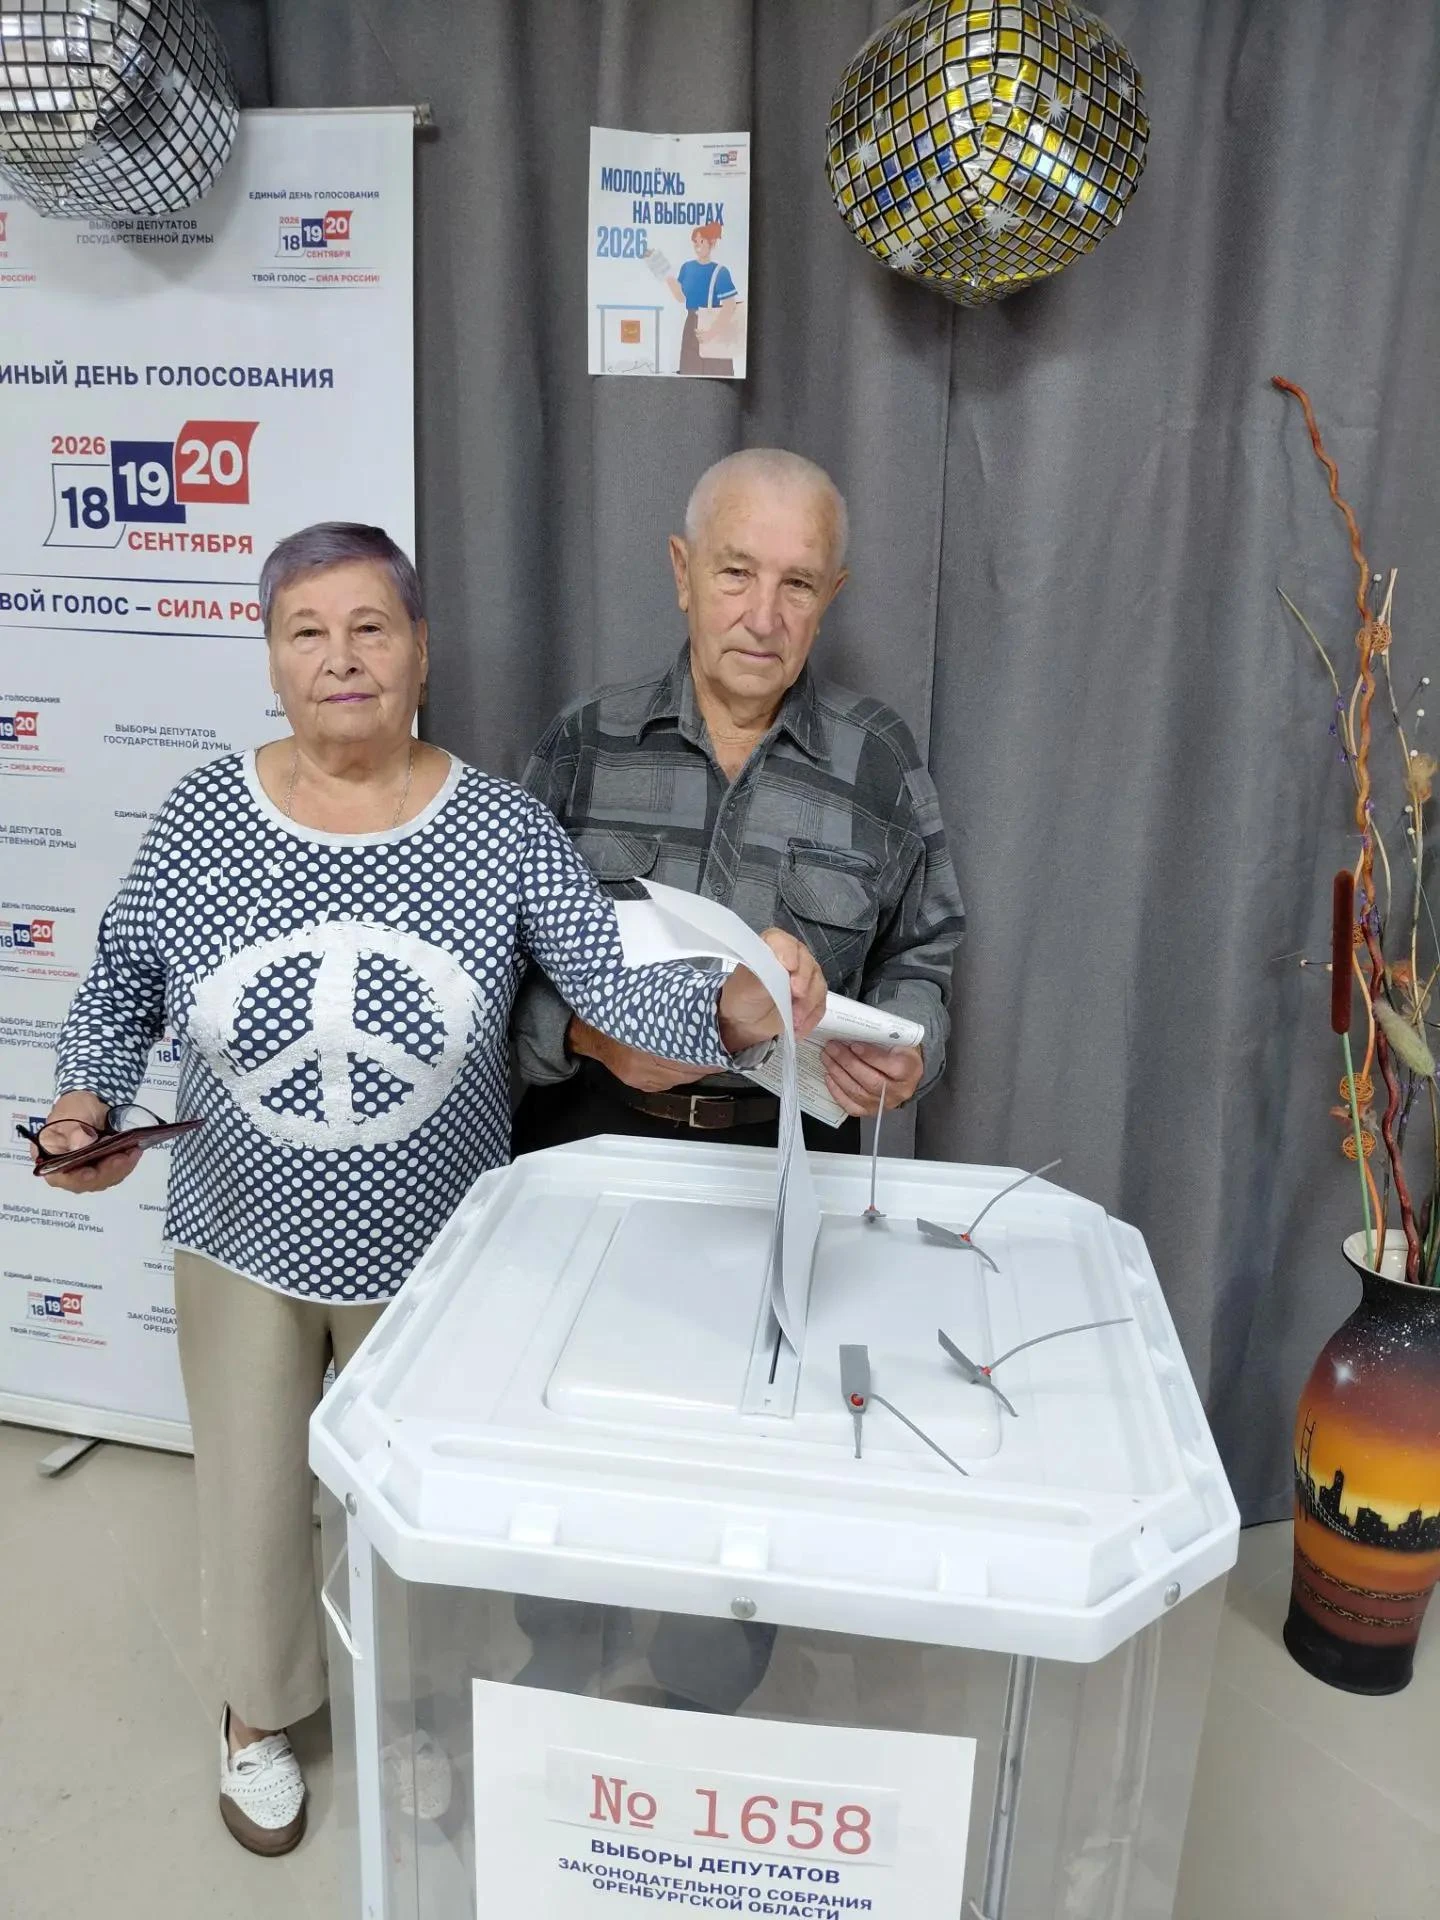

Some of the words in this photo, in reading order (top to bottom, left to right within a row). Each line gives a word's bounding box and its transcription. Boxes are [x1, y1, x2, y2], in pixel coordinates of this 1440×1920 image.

[601, 167, 685, 198] МОЛОДЁЖЬ
[249, 189, 287, 200] ЕДИНЫЙ
[289, 191, 312, 200] ДЕНЬ
[314, 191, 380, 199] ГОЛОСОВАНИЯ
[633, 200, 652, 224] НА
[654, 201, 724, 226] ВЫБОРАХ
[136, 220, 198, 231] ДЕПУТАТОВ
[282, 235, 300, 251] 18
[303, 225, 322, 242] 19
[325, 216, 348, 234] 20
[77, 232, 179, 245] ГОСУДАРСТВЕННОЙ
[181, 234, 214, 245] ДУМЫ
[596, 225, 648, 259] 2026
[252, 272, 276, 282] ТВОЙ
[277, 274, 307, 282] ГОЛОС
[75, 365, 139, 388] ДЕНЬ
[146, 366, 334, 388] ГОЛОСОВАНИЯ
[51, 435, 106, 455] 2026
[61, 486, 110, 530] 18
[118, 461, 170, 507] 19
[180, 439, 243, 486] 20
[128, 531, 253, 554] СЕНТЯБРЯ
[52, 595, 129, 615] ГОЛОС
[157, 598, 224, 620] СИЛА
[16, 716, 35, 732] 20
[115, 724, 157, 734] ВЫБОРЫ
[159, 727, 217, 738] ДЕПУТАТОВ
[103, 736, 200, 749] ГОСУДАРСТВЕННОЙ
[201, 741, 232, 751] ДУМЫ
[9, 825, 63, 837] ДЕПУТАТОВ
[48, 839, 77, 848] ДУМЫ
[14, 929, 31, 943] 19
[32, 924, 51, 938] 20
[156, 1050, 172, 1063] 18
[153, 1079, 178, 1087] ГОЛОС
[3, 1203, 40, 1215] ВЫБОРЫ
[41, 1208, 90, 1221] ДЕПУТАТОВ
[77, 1223, 104, 1233] ДУМЫ
[143, 1262, 162, 1270] ТВОЙ
[31, 1304, 44, 1316] 18
[46, 1300, 61, 1313] 19
[63, 1298, 79, 1310] 20
[693, 1788, 872, 1855] 1658
[592, 1839, 692, 1869] ВЫБОРЫ
[699, 1857, 840, 1884] ДЕПУТАТОВ
[558, 1857, 761, 1899] ЗАКОНОДАТЕЛЬНОГО
[767, 1889, 872, 1911] СОБРАНИЯ
[592, 1878, 742, 1911] ОРЕНБУРГСКОЙ
[748, 1901, 839, 1920] ОБЛАСТИ
